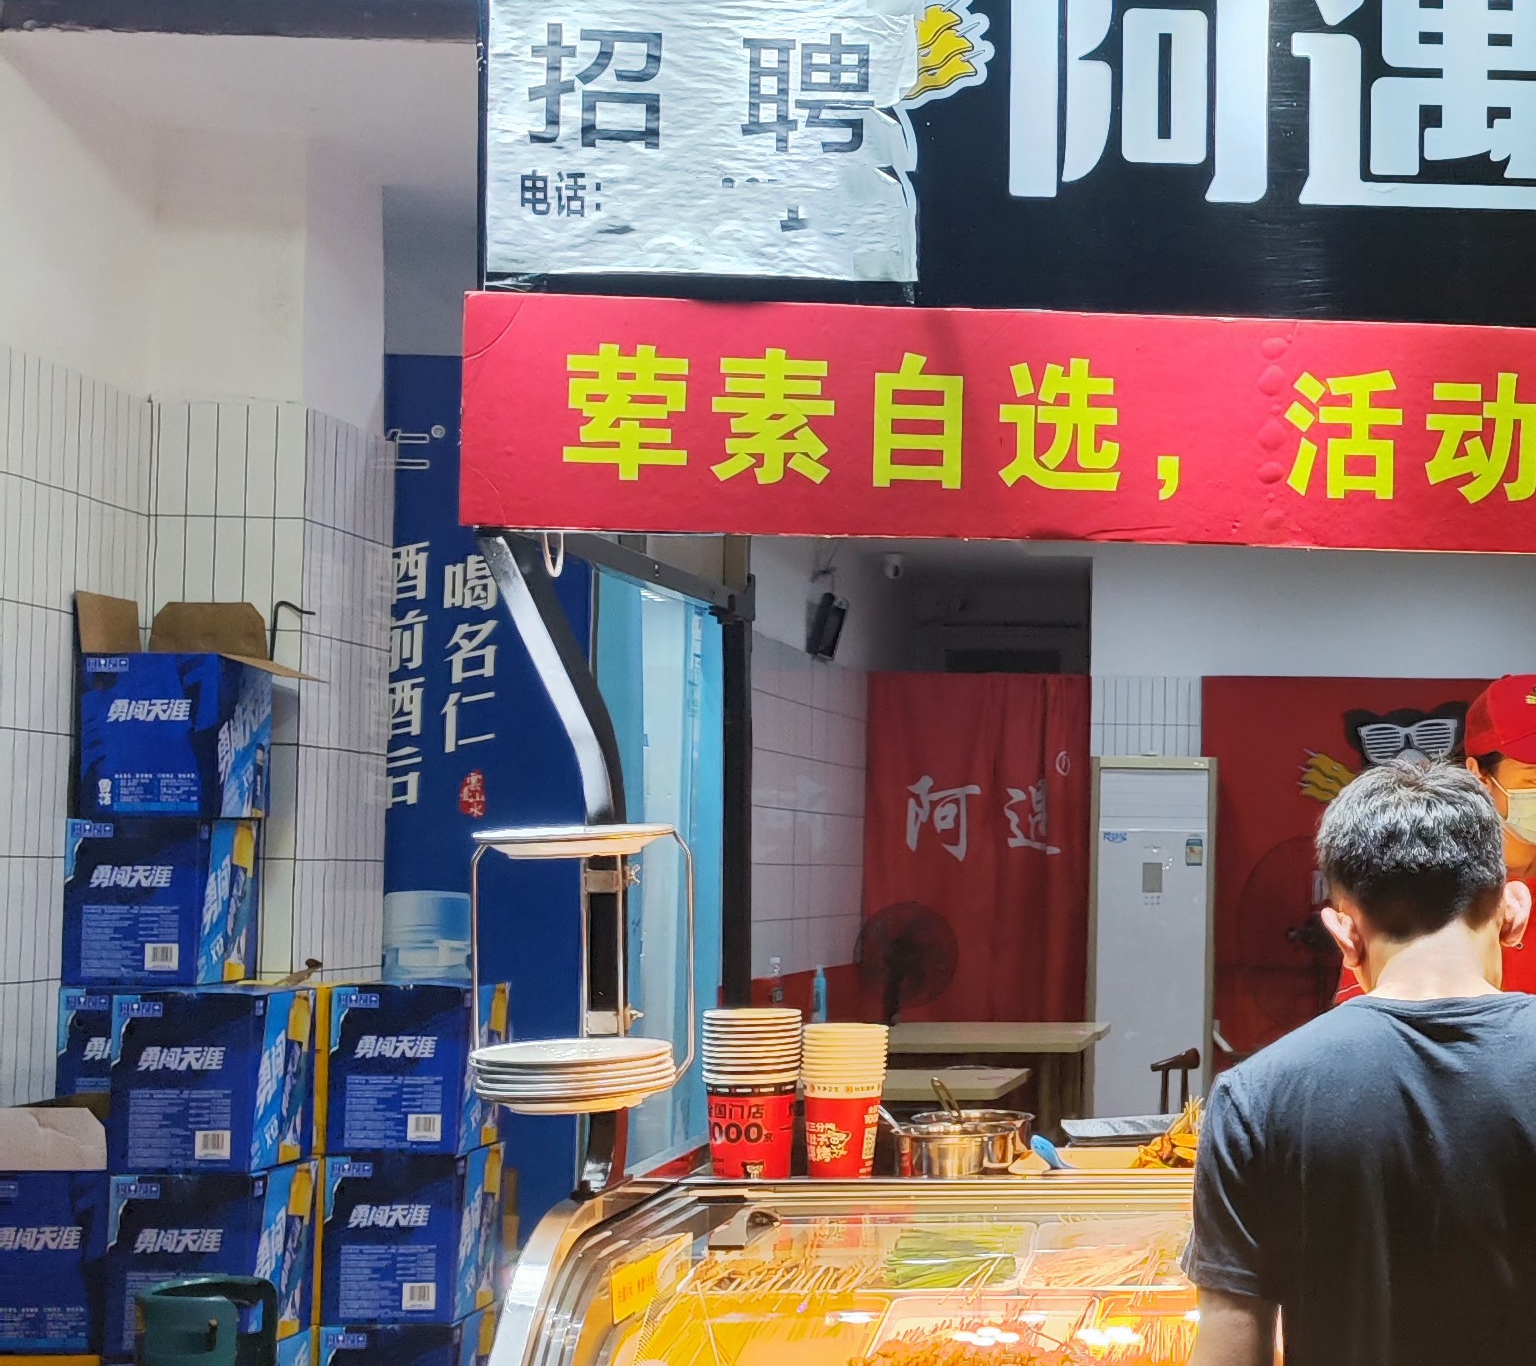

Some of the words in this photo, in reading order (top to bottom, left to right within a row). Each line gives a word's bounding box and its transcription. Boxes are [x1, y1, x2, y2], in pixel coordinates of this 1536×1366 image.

[440, 554, 499, 754] 喝名仁
[107, 698, 193, 722] 勇闯天涯
[89, 865, 174, 888] 勇闯天涯
[138, 1046, 226, 1072] 勇闯天涯
[354, 1034, 438, 1059] 勇闯天涯
[347, 1204, 432, 1229] 勇闯天涯
[133, 1228, 223, 1254] 勇闯天涯
